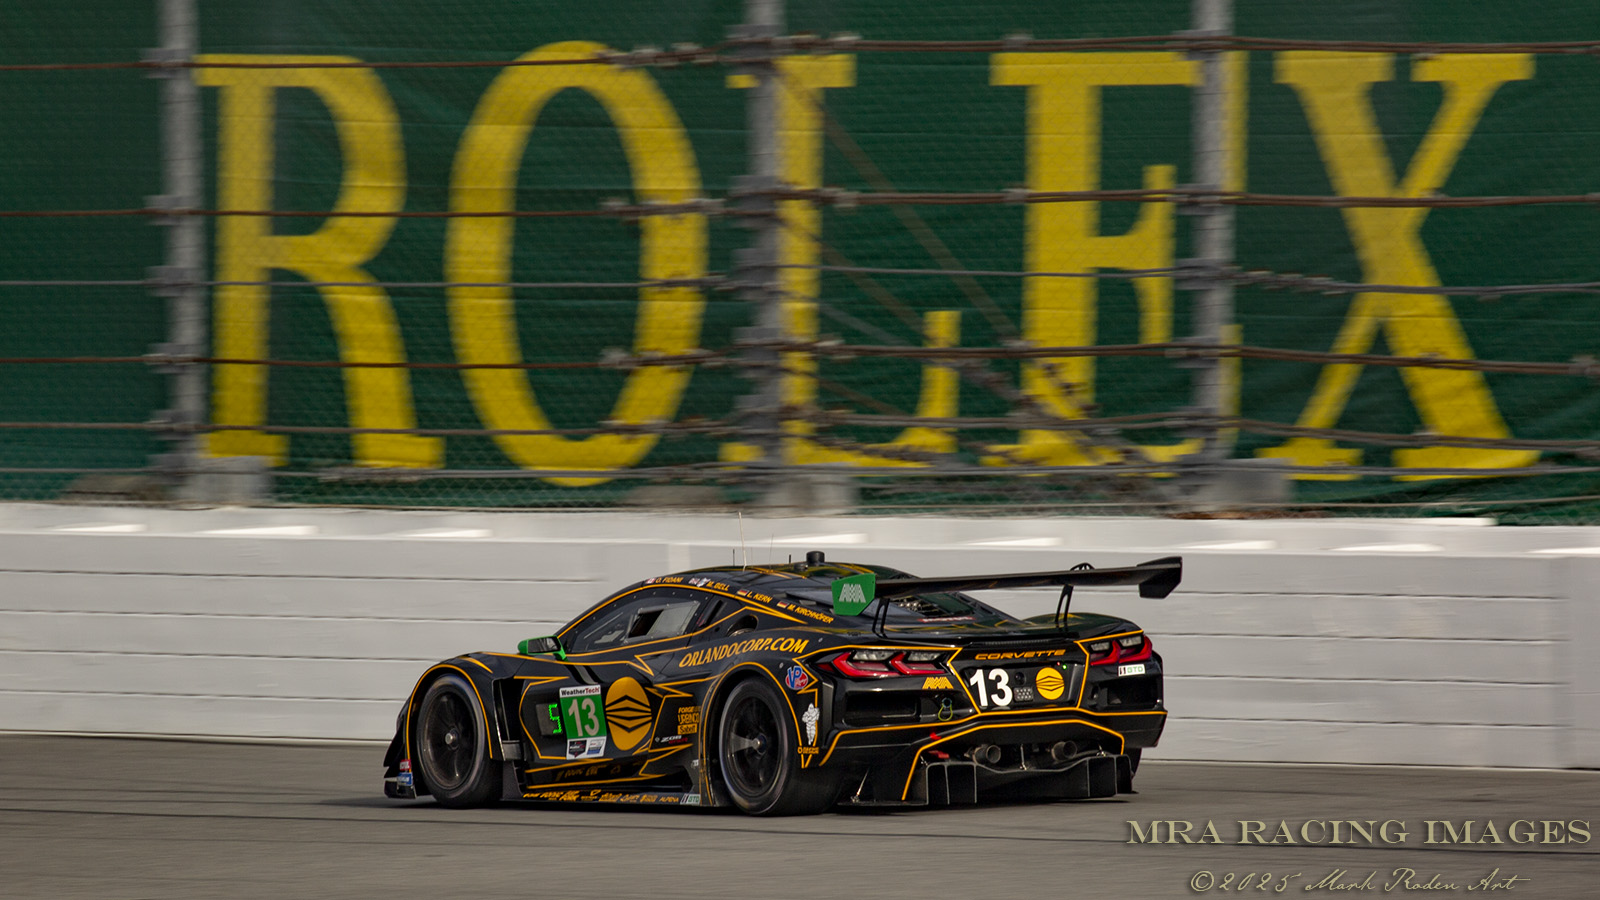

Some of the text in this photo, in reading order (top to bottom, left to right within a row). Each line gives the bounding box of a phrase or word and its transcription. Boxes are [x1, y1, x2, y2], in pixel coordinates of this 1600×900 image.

[192, 40, 1538, 486] ROLEX
[713, 582, 730, 591] BELL
[752, 592, 773, 603] KERN
[679, 637, 809, 668] ORLANDOCORP.COM
[975, 649, 1066, 660] CORVETTE
[561, 687, 600, 696] WeatherTech
[969, 668, 1013, 707] 13
[568, 698, 600, 737] 13
